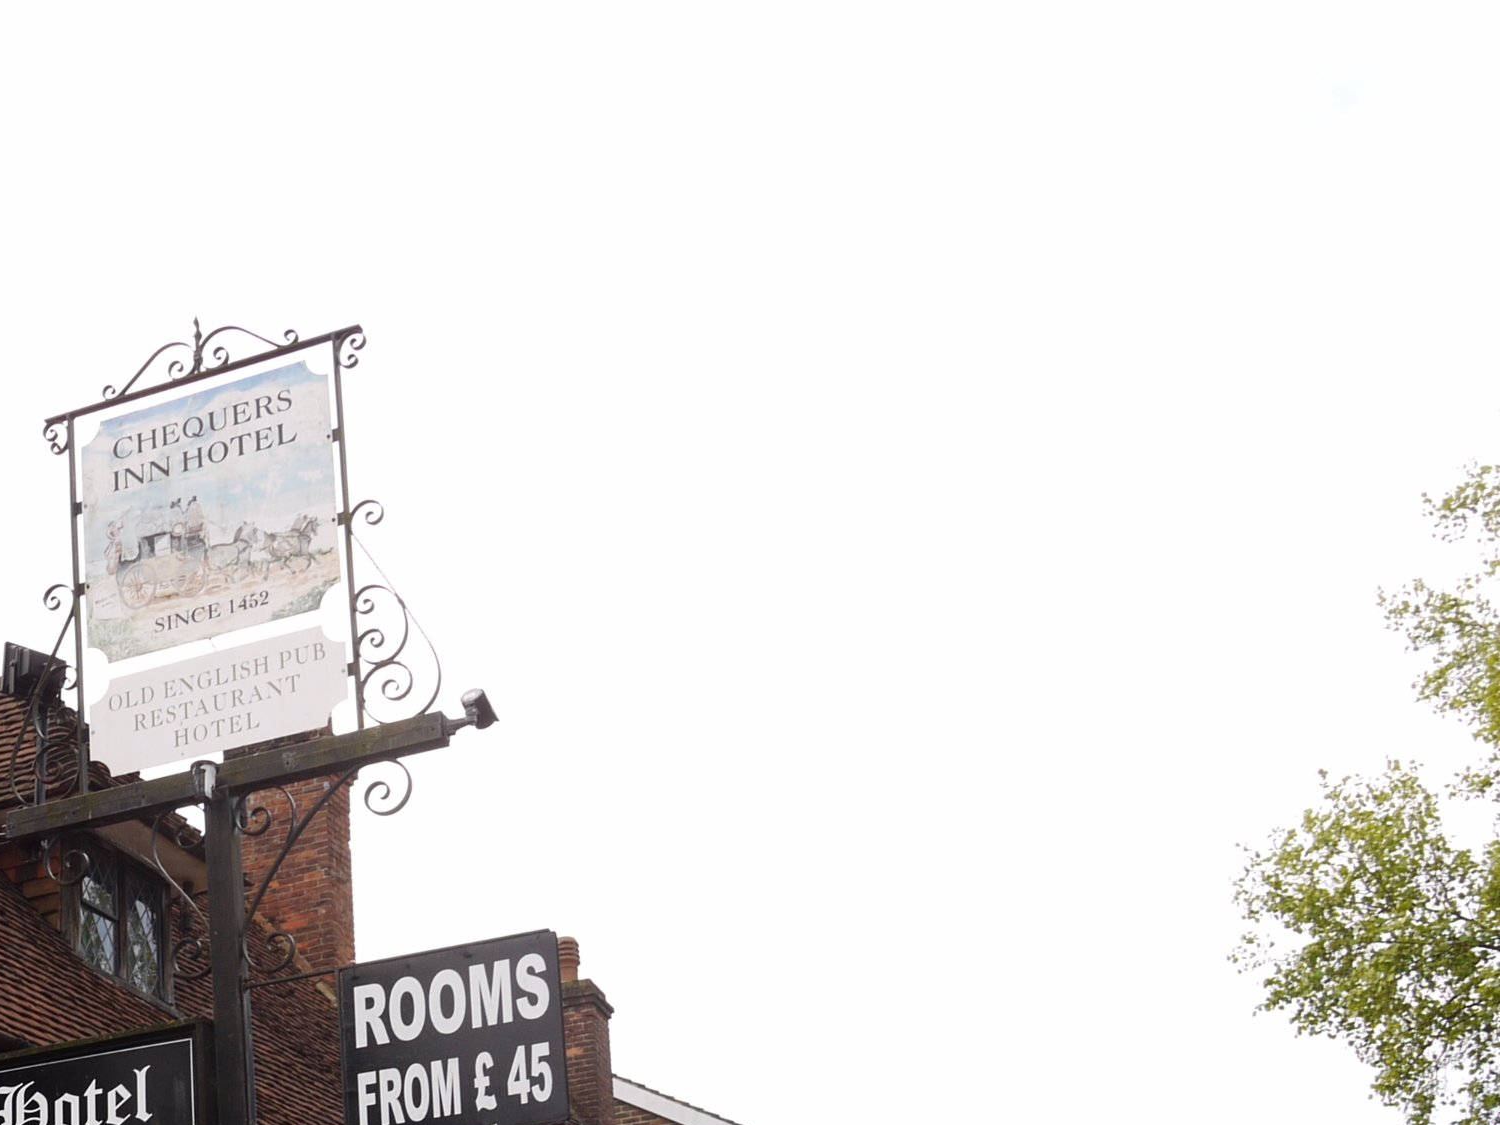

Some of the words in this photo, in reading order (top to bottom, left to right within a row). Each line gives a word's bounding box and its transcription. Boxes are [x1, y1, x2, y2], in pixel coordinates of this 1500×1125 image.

[112, 389, 294, 460] CHEQUERS
[113, 456, 171, 491] INN
[182, 423, 297, 473] HOTEL
[154, 602, 221, 633] SINCE
[229, 591, 269, 615] 1452
[108, 685, 154, 712] OLD
[164, 656, 269, 699] ENGLISH
[279, 642, 326, 671] PUB
[133, 674, 300, 732] RESTAURANT
[174, 712, 260, 747] HOTEL
[353, 953, 549, 1048] ROOMS
